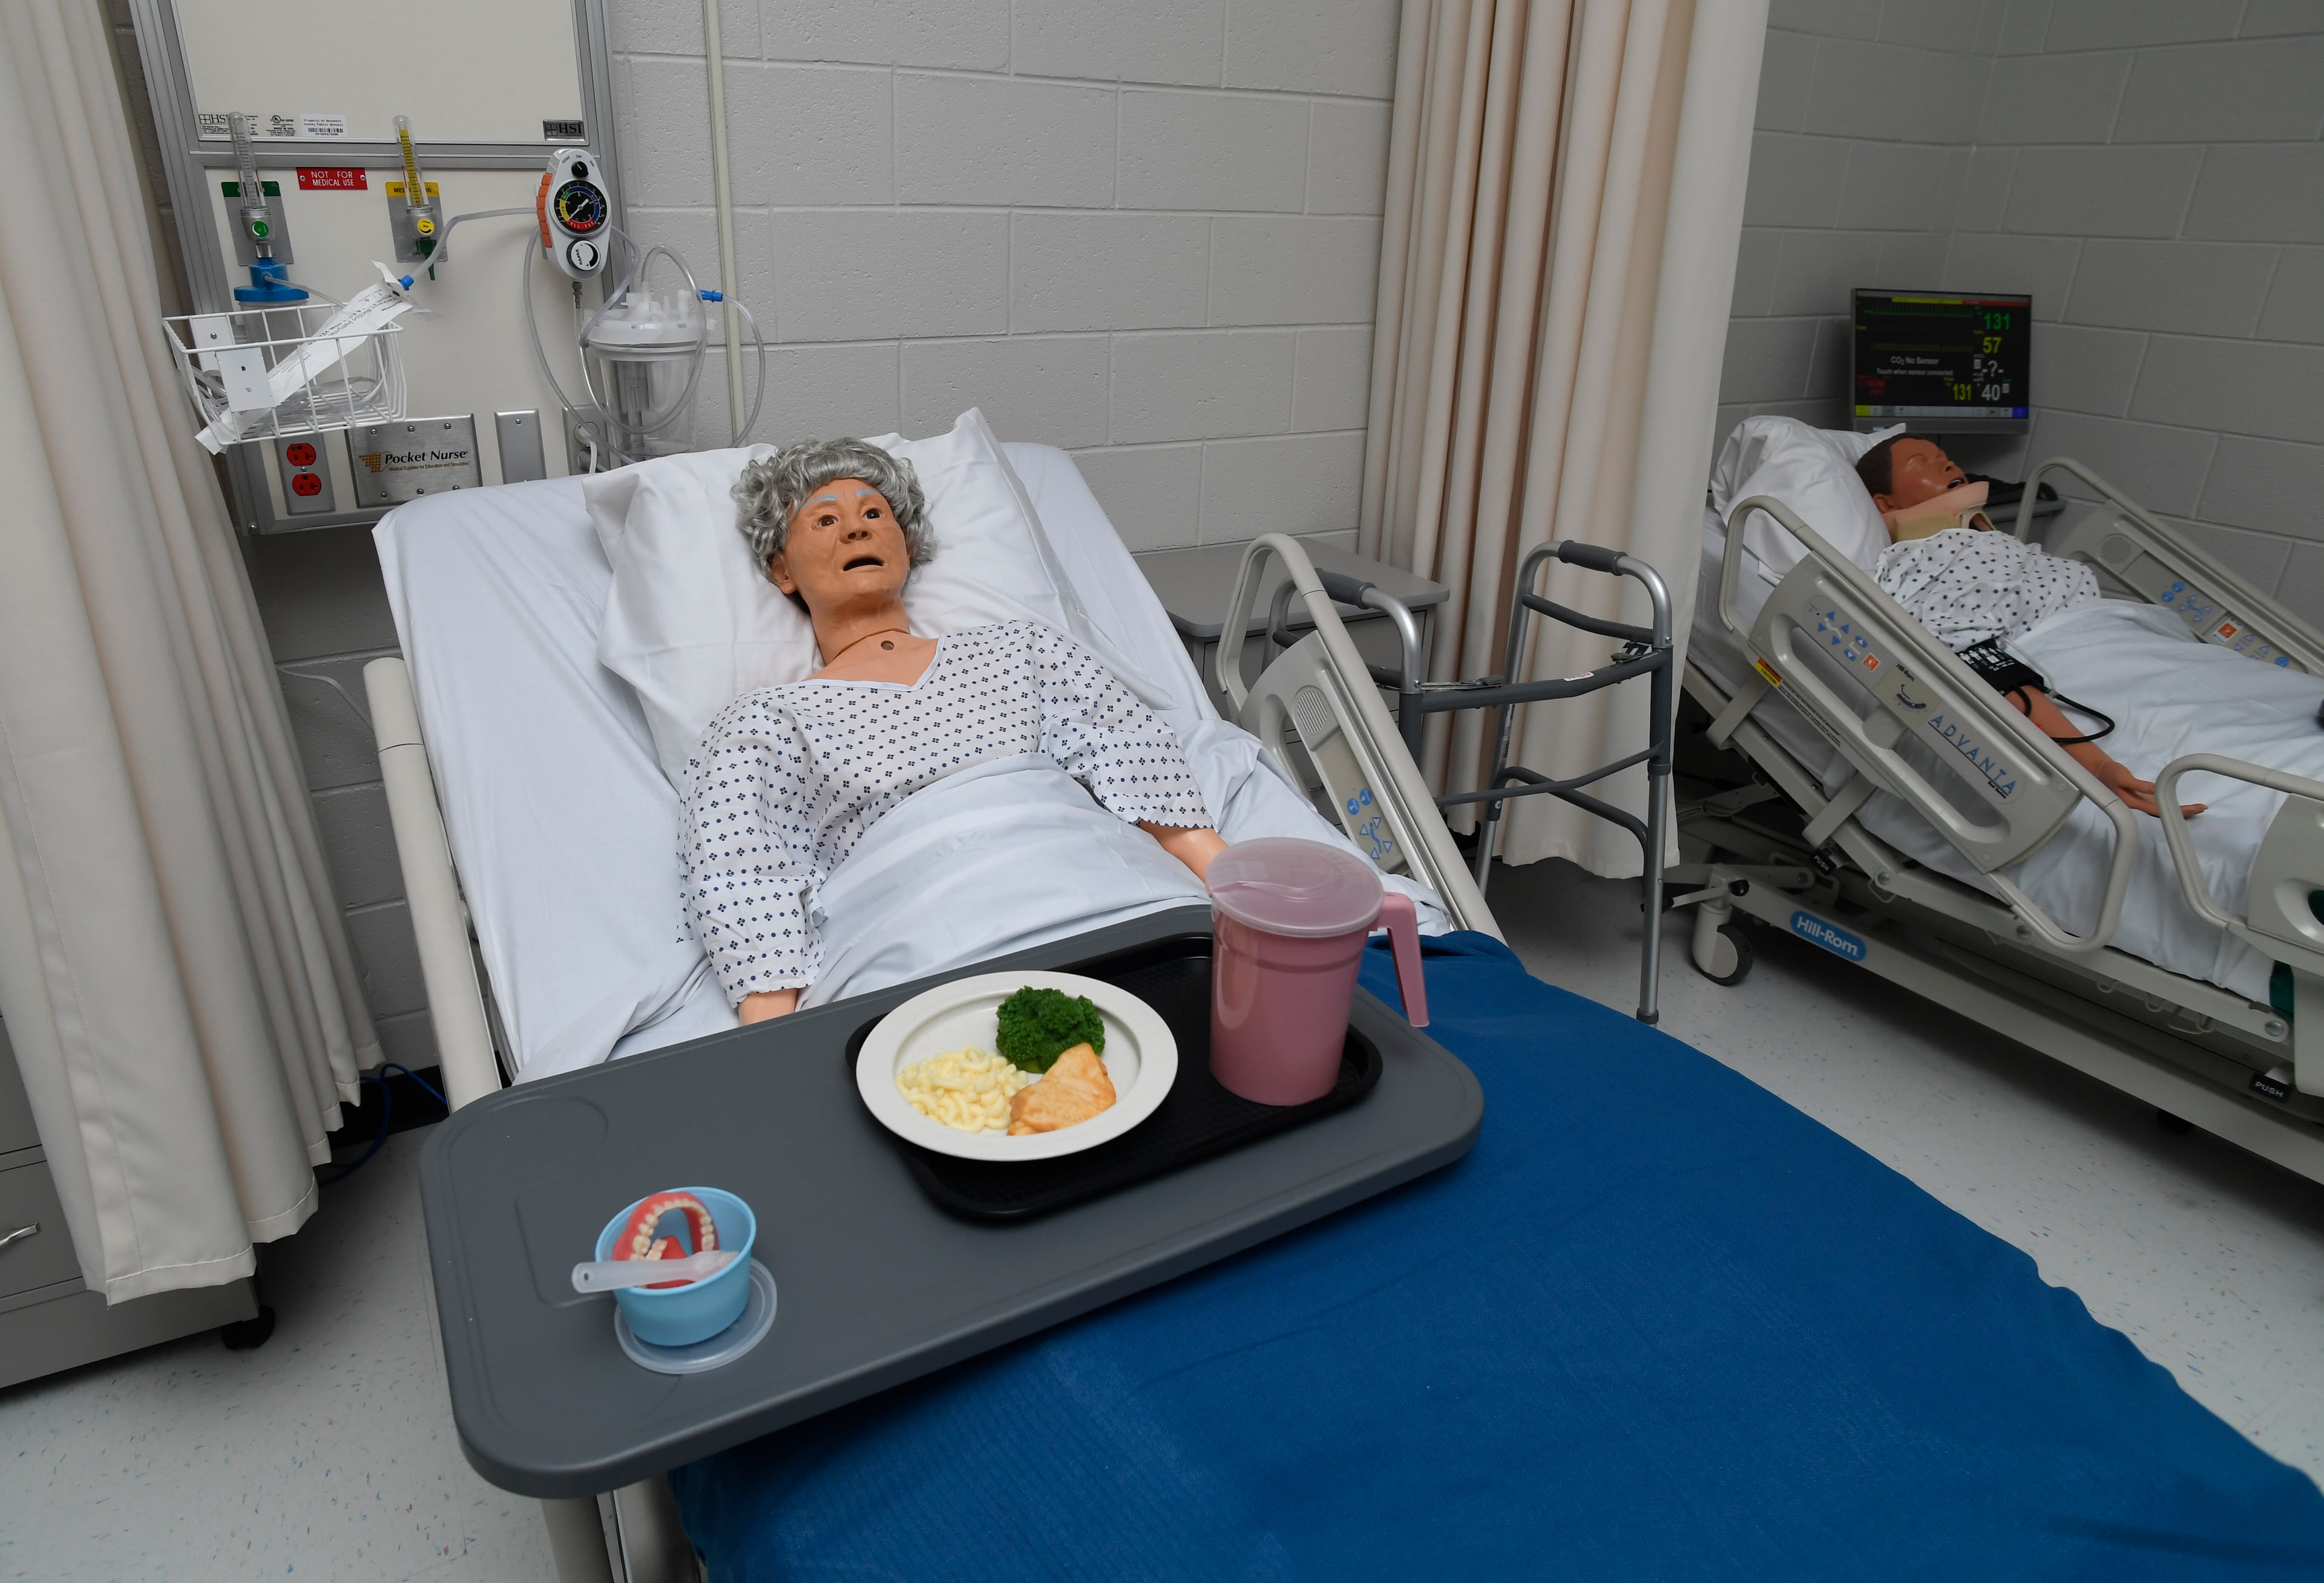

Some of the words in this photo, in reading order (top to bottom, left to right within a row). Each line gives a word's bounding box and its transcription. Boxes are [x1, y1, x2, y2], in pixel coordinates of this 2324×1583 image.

[211, 114, 228, 123] HS
[558, 123, 582, 134] HSI
[353, 309, 372, 321] Suction
[1983, 312, 2011, 330] 131
[1983, 336, 2002, 353] 57
[1952, 383, 1972, 401] 131
[1981, 384, 2001, 401] 40
[385, 451, 425, 464] Pocket
[1931, 715, 2017, 794] ADVANTA
[1814, 855, 1830, 871] PUSH
[1797, 916, 1858, 955] Hill-Rom
[2255, 1081, 2283, 1098] PUSH
